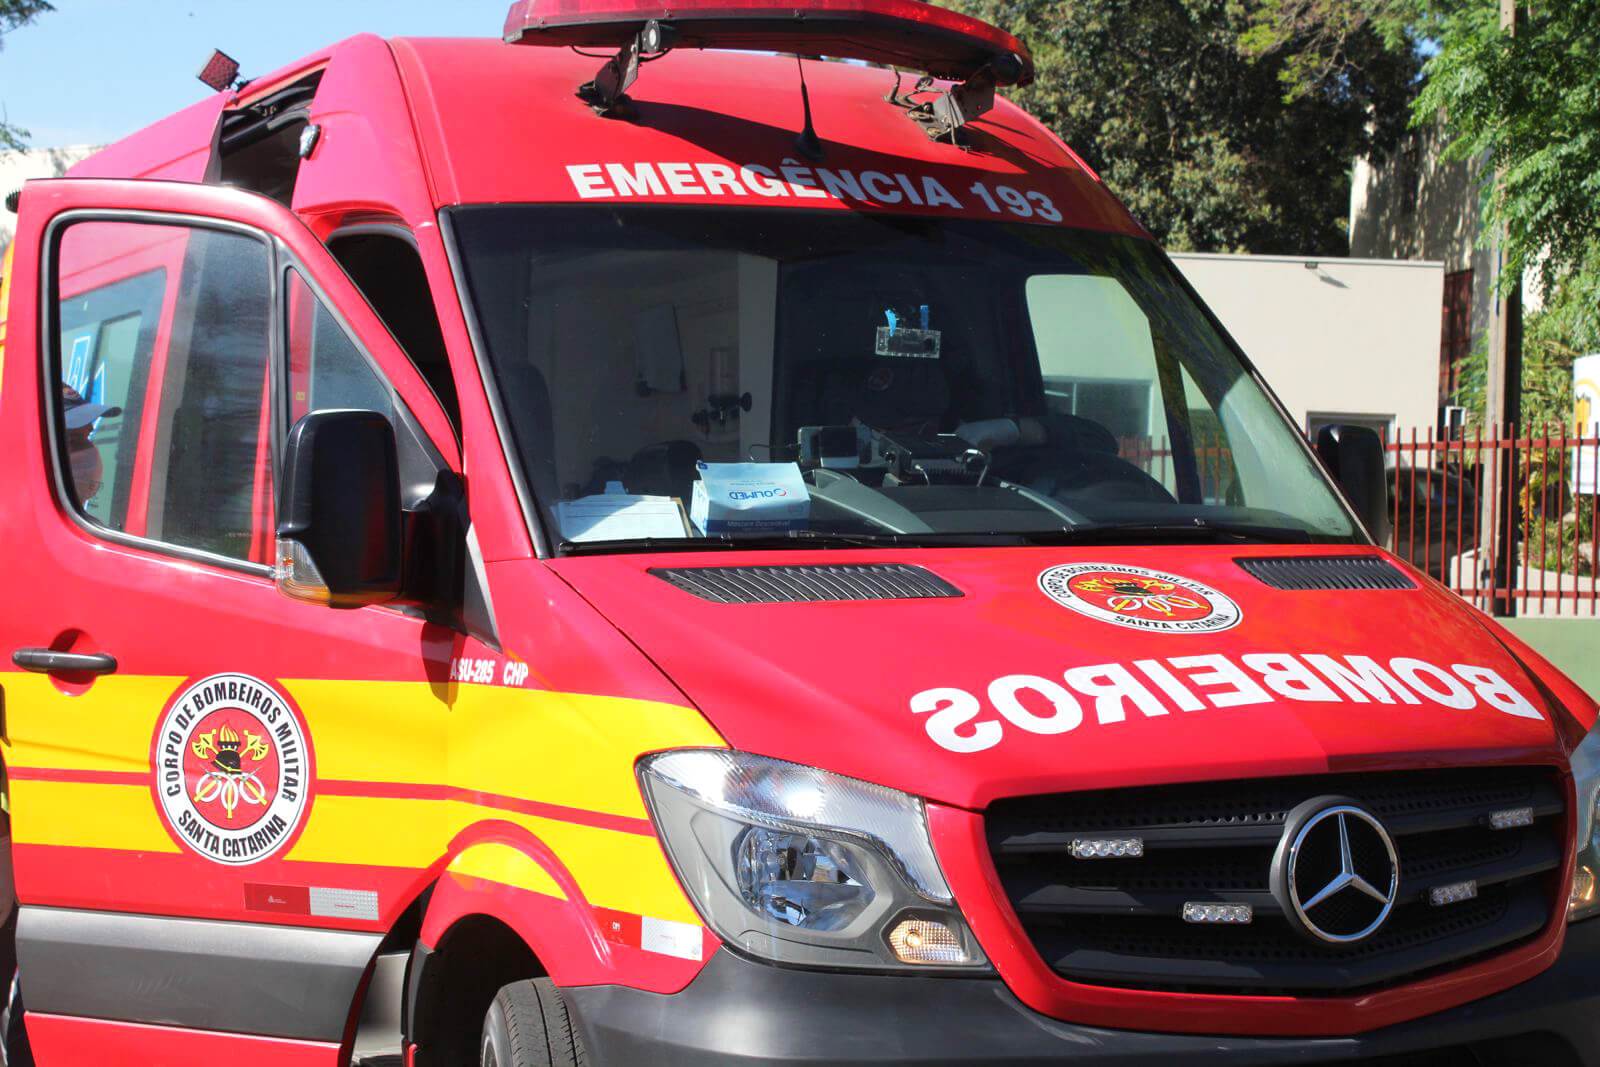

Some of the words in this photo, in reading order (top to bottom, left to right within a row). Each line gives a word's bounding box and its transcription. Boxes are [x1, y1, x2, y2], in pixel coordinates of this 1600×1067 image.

[565, 158, 963, 210] EMERGÊNCIA
[969, 182, 1063, 223] 193
[1115, 614, 1173, 630] SANTA
[503, 661, 529, 685] CHP
[164, 729, 183, 798] CORPO
[175, 703, 196, 732] DE
[191, 681, 282, 725] BOMBEIROS
[274, 721, 299, 803] MILITAR
[178, 809, 220, 856] SANTA
[222, 813, 288, 858] CATARINA
